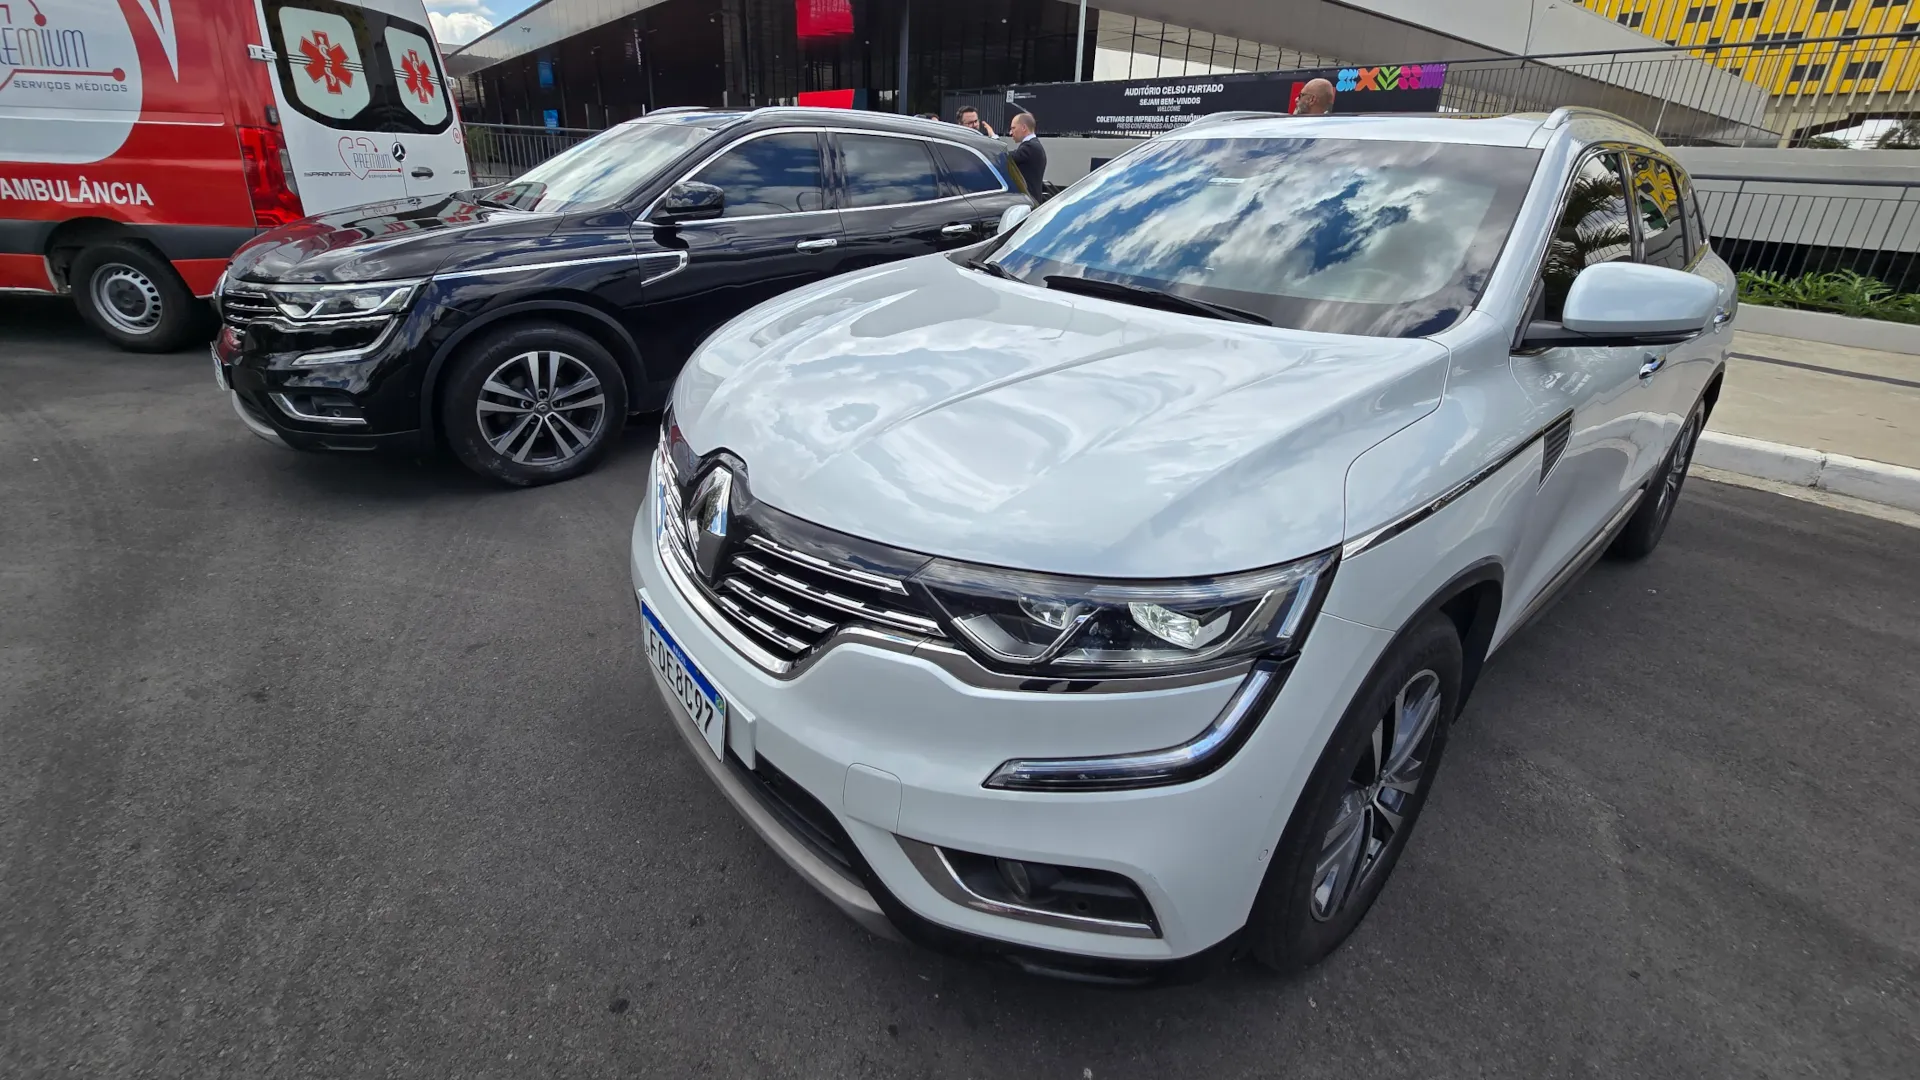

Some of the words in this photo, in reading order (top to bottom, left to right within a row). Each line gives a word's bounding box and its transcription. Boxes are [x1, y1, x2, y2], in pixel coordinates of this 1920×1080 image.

[0, 27, 89, 68] EMIUM
[13, 80, 71, 92] SERVIÇOS
[75, 80, 128, 92] MÉDICOS
[1124, 85, 1161, 96] AUDITÓRIO
[1162, 85, 1186, 95] CELSO
[1187, 84, 1224, 94] FURTADO
[1139, 98, 1160, 106] SEJAM
[1160, 97, 1201, 105] BEM-VINDOS
[1096, 115, 1125, 123] COLETIVAS
[353, 152, 392, 169] PREMIUM
[0, 175, 154, 206] AMBULÂNCIA
